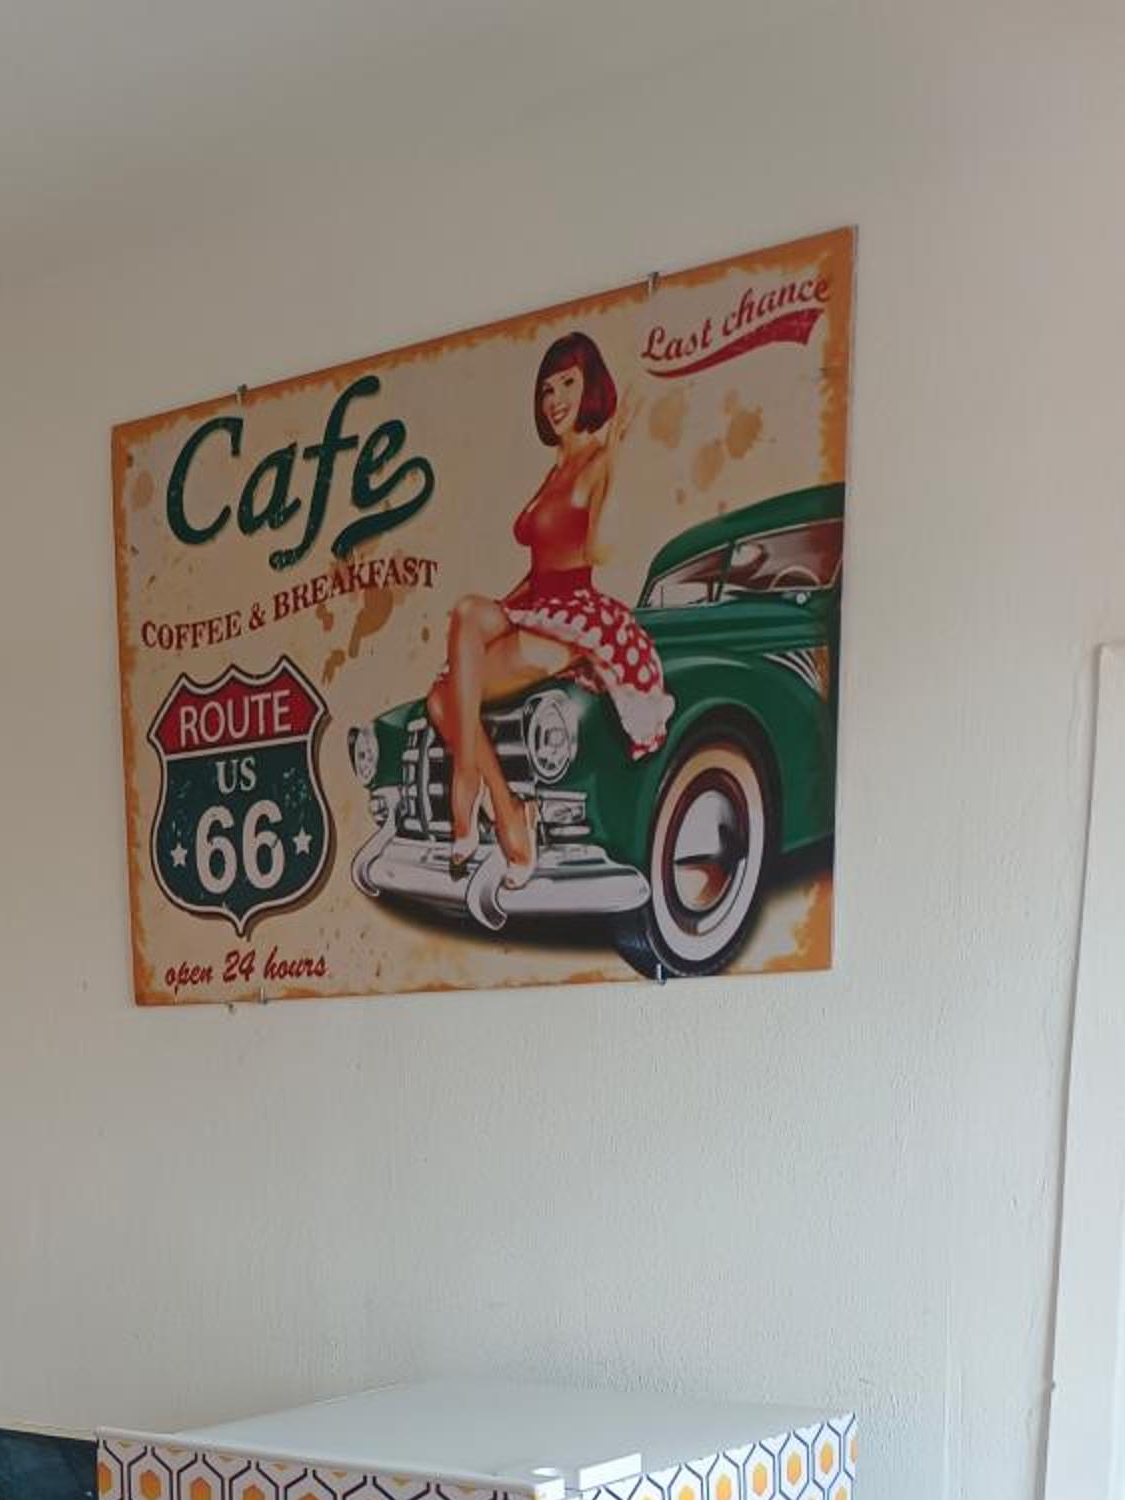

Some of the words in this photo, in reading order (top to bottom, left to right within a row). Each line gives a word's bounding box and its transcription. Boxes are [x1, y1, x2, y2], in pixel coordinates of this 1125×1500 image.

[640, 317, 713, 361] Last
[721, 273, 830, 337] chance
[166, 375, 435, 571] Cafe
[141, 610, 242, 651] COFFEE
[248, 602, 266, 631] &
[273, 556, 439, 622] BREAKFAST
[179, 689, 293, 748] ROUTE
[215, 756, 258, 794] US
[195, 799, 286, 895] 66
[164, 961, 214, 994] open
[222, 948, 256, 983] 24
[263, 945, 329, 981] hours
